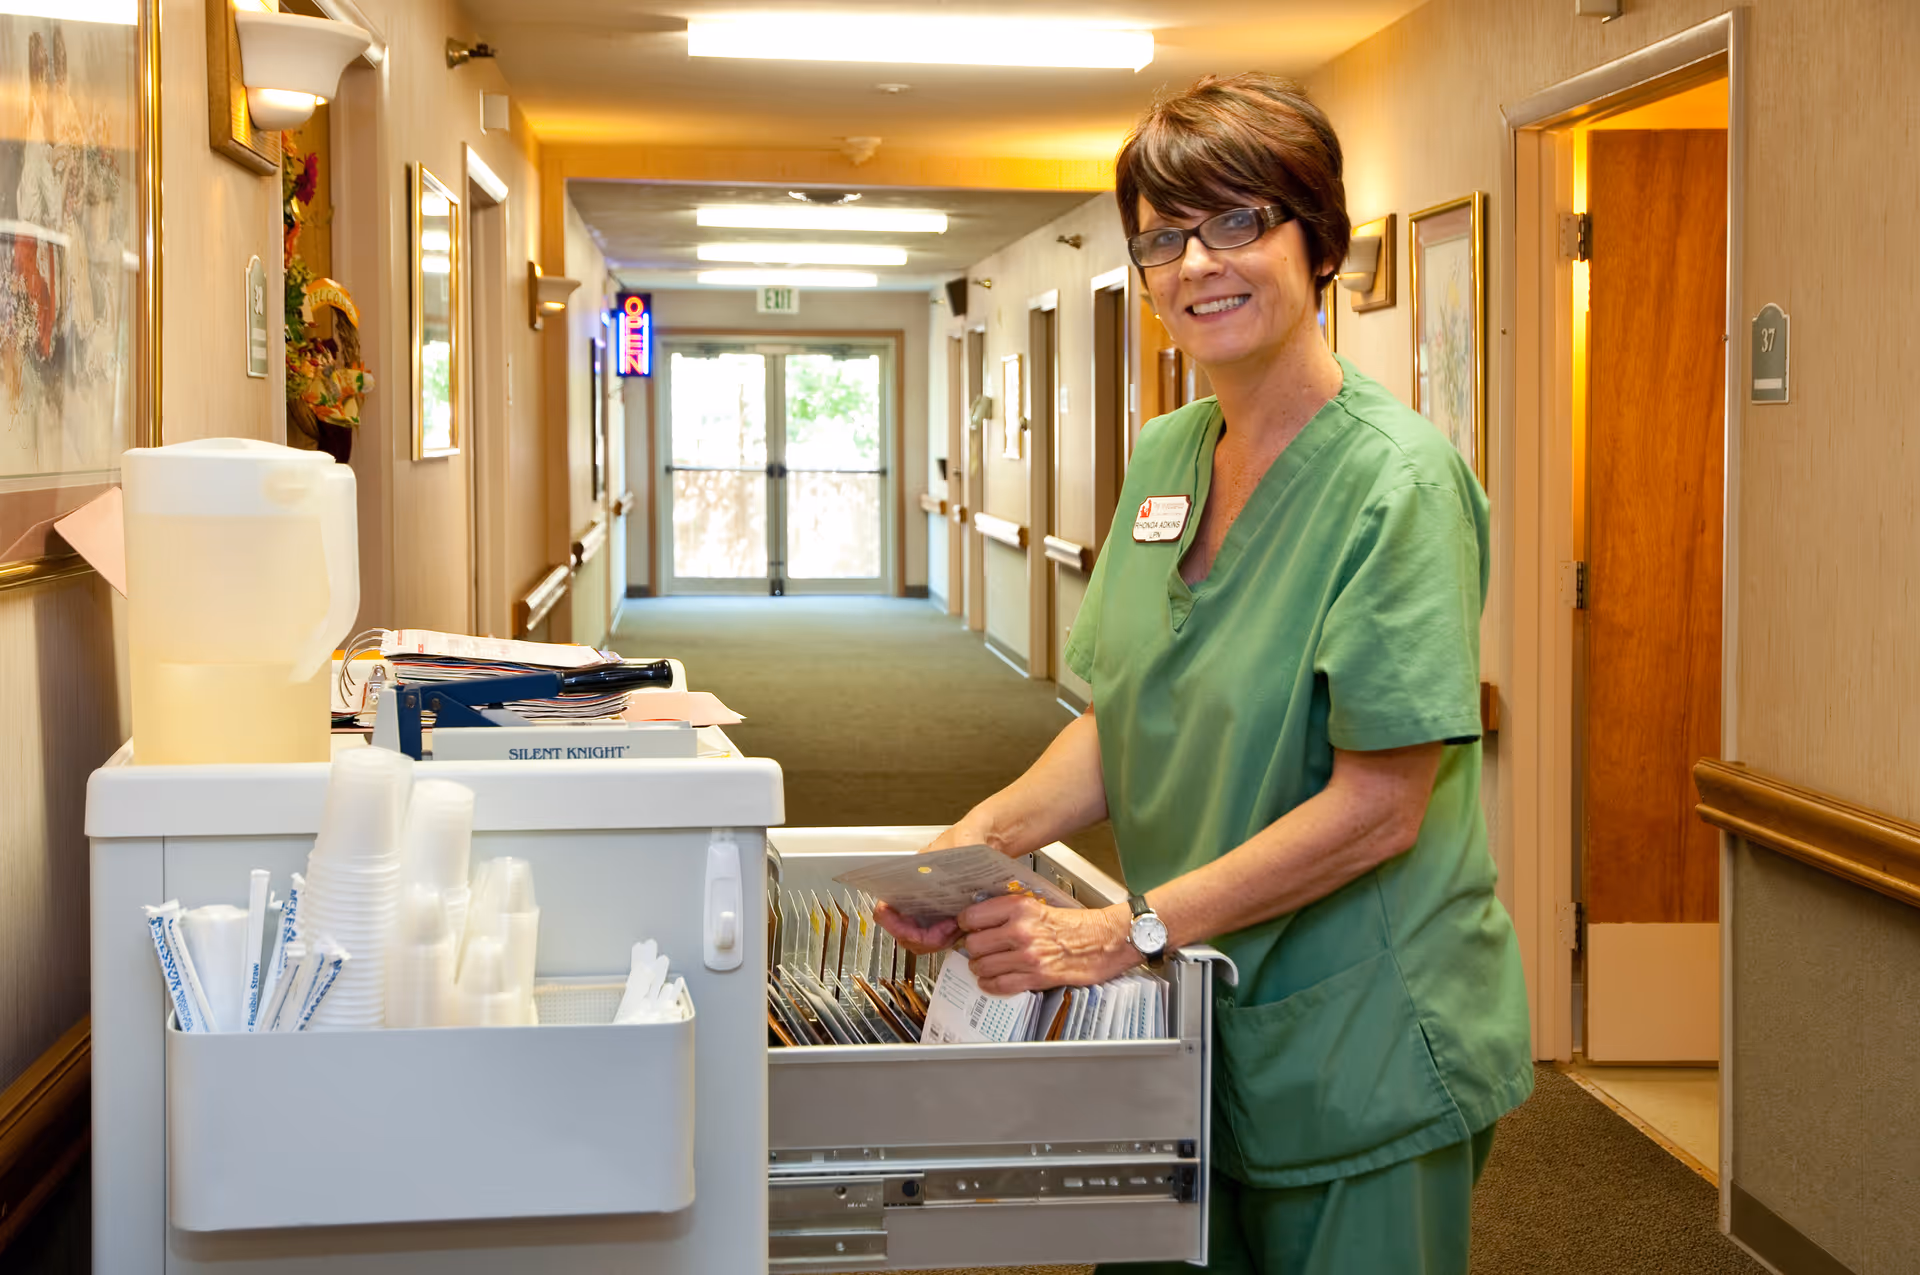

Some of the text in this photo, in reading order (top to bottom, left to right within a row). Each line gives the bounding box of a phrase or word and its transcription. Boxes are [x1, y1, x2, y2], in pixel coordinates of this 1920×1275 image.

[764, 288, 792, 309] EXIT
[624, 296, 644, 374] OPEN
[1761, 328, 1775, 352] 37
[1159, 520, 1180, 528] ADKINS
[509, 746, 625, 760] SILENT KNIGHT
[250, 962, 260, 989] Straw
